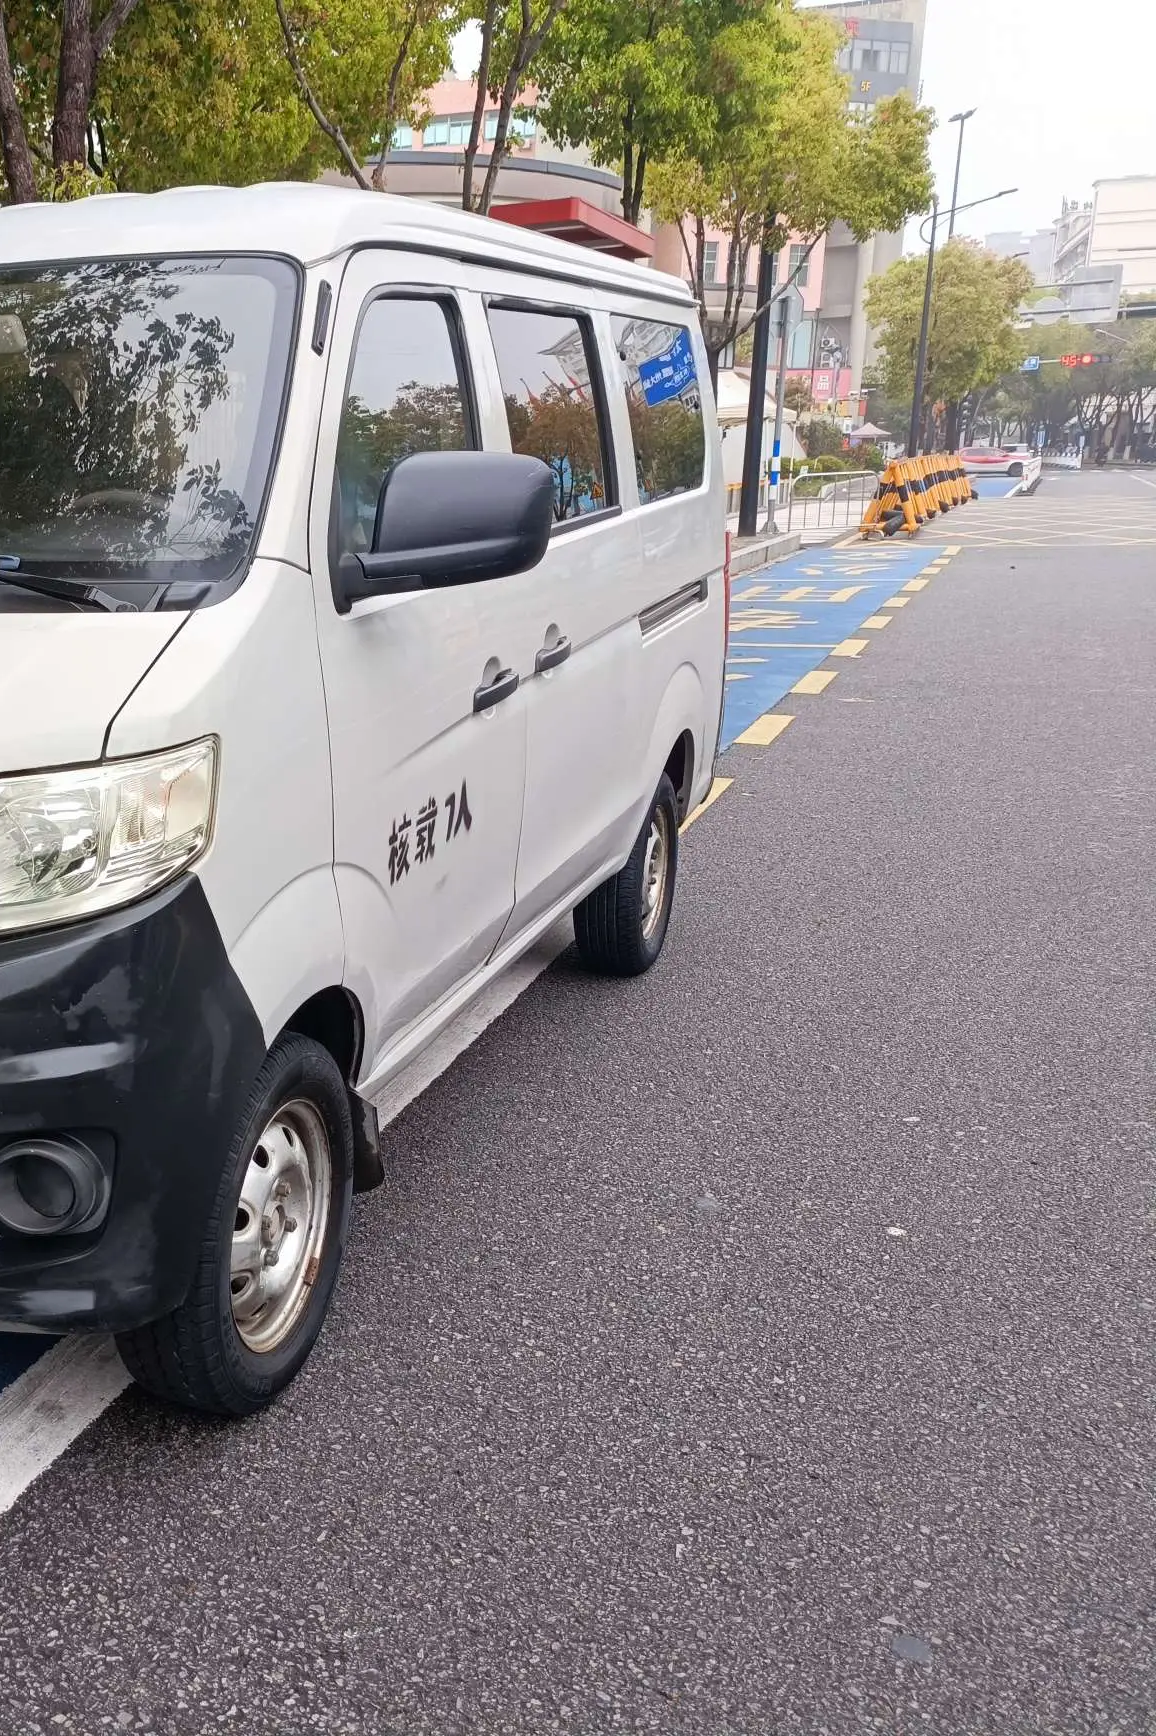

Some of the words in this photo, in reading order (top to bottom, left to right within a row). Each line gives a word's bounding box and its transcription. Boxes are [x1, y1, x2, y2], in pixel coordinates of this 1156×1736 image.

[860, 80, 872, 92] 5F
[1061, 355, 1077, 368] 45
[387, 776, 473, 887] 核载7人
